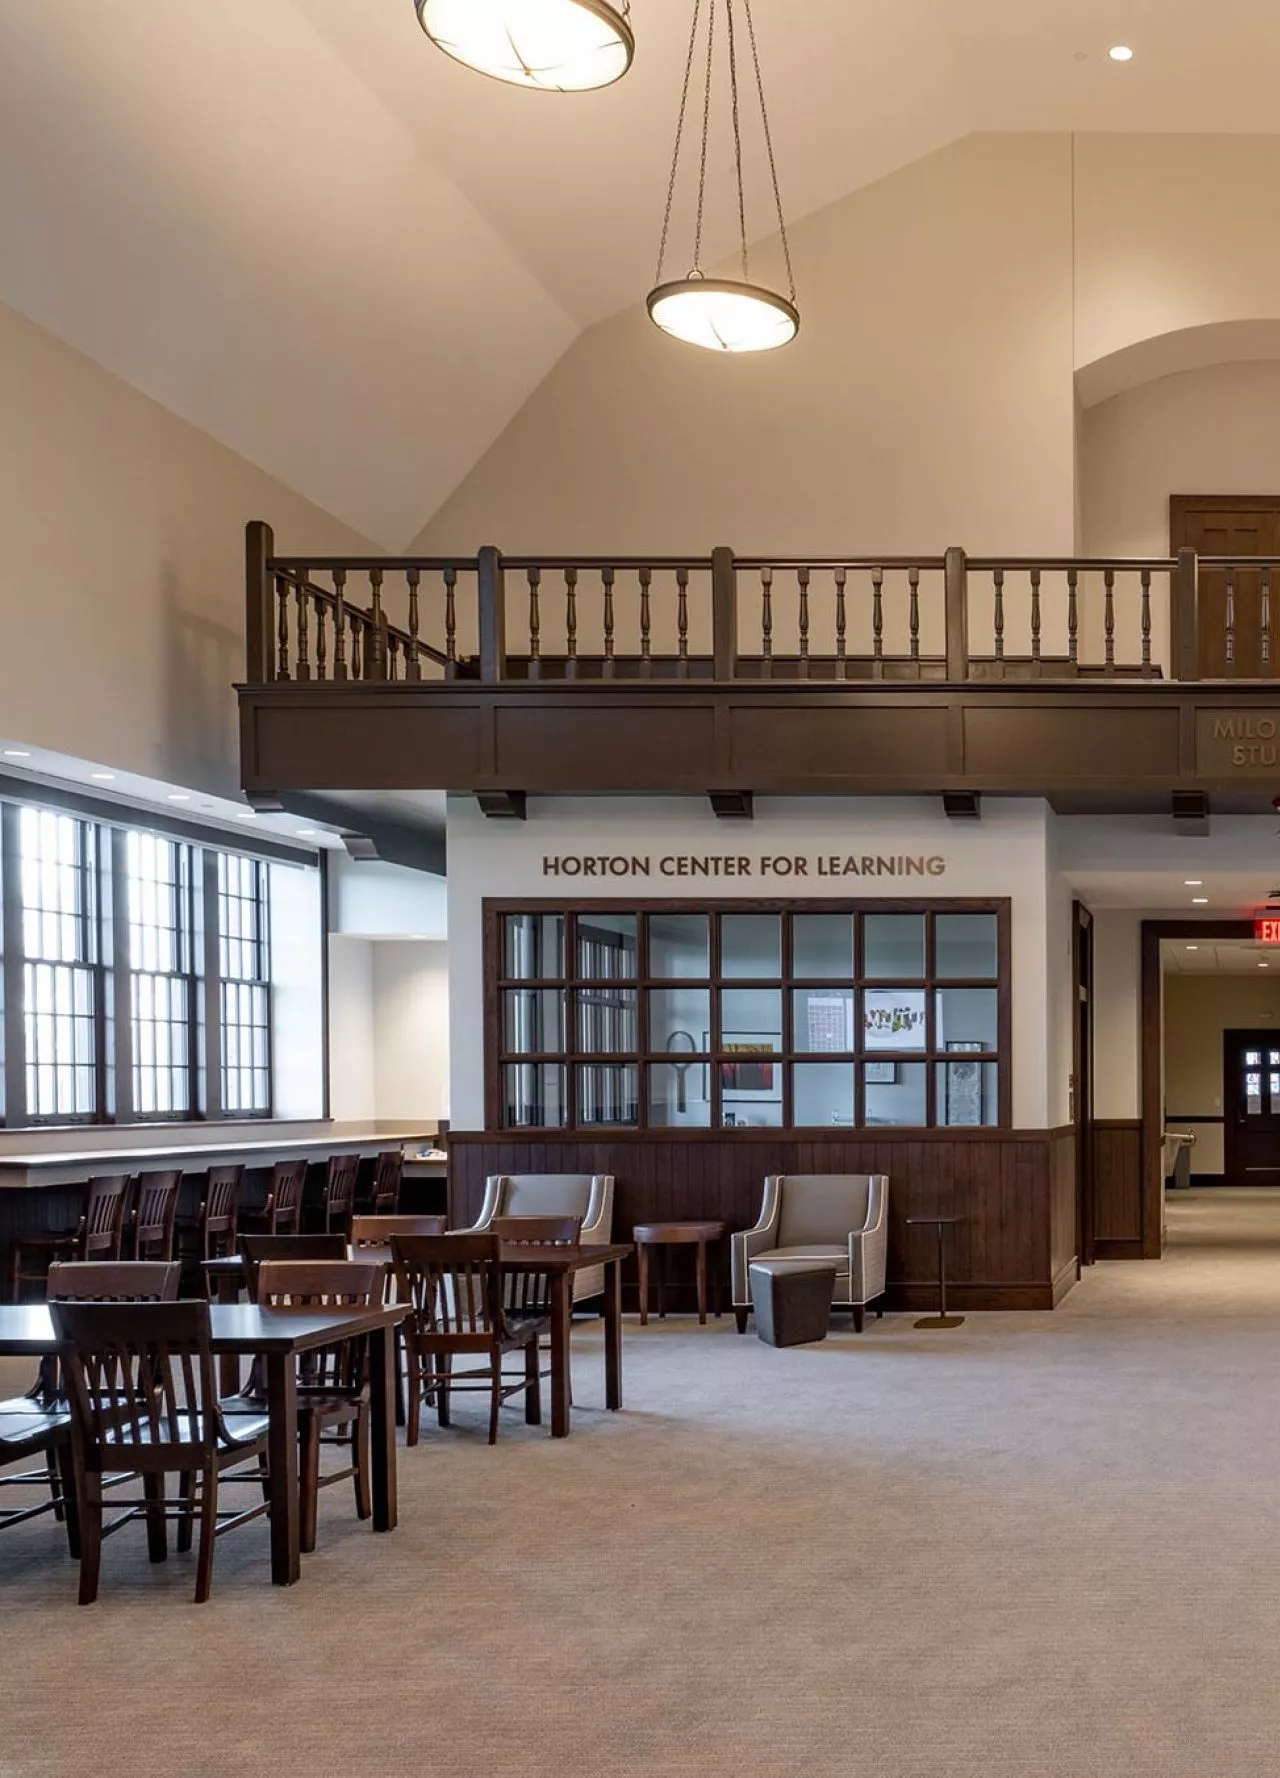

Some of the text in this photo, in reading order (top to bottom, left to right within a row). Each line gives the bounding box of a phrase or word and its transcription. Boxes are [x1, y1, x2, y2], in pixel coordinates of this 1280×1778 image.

[1213, 718, 1276, 739] MILO
[542, 855, 946, 876] HORTON CENTER FOR LEARNING
